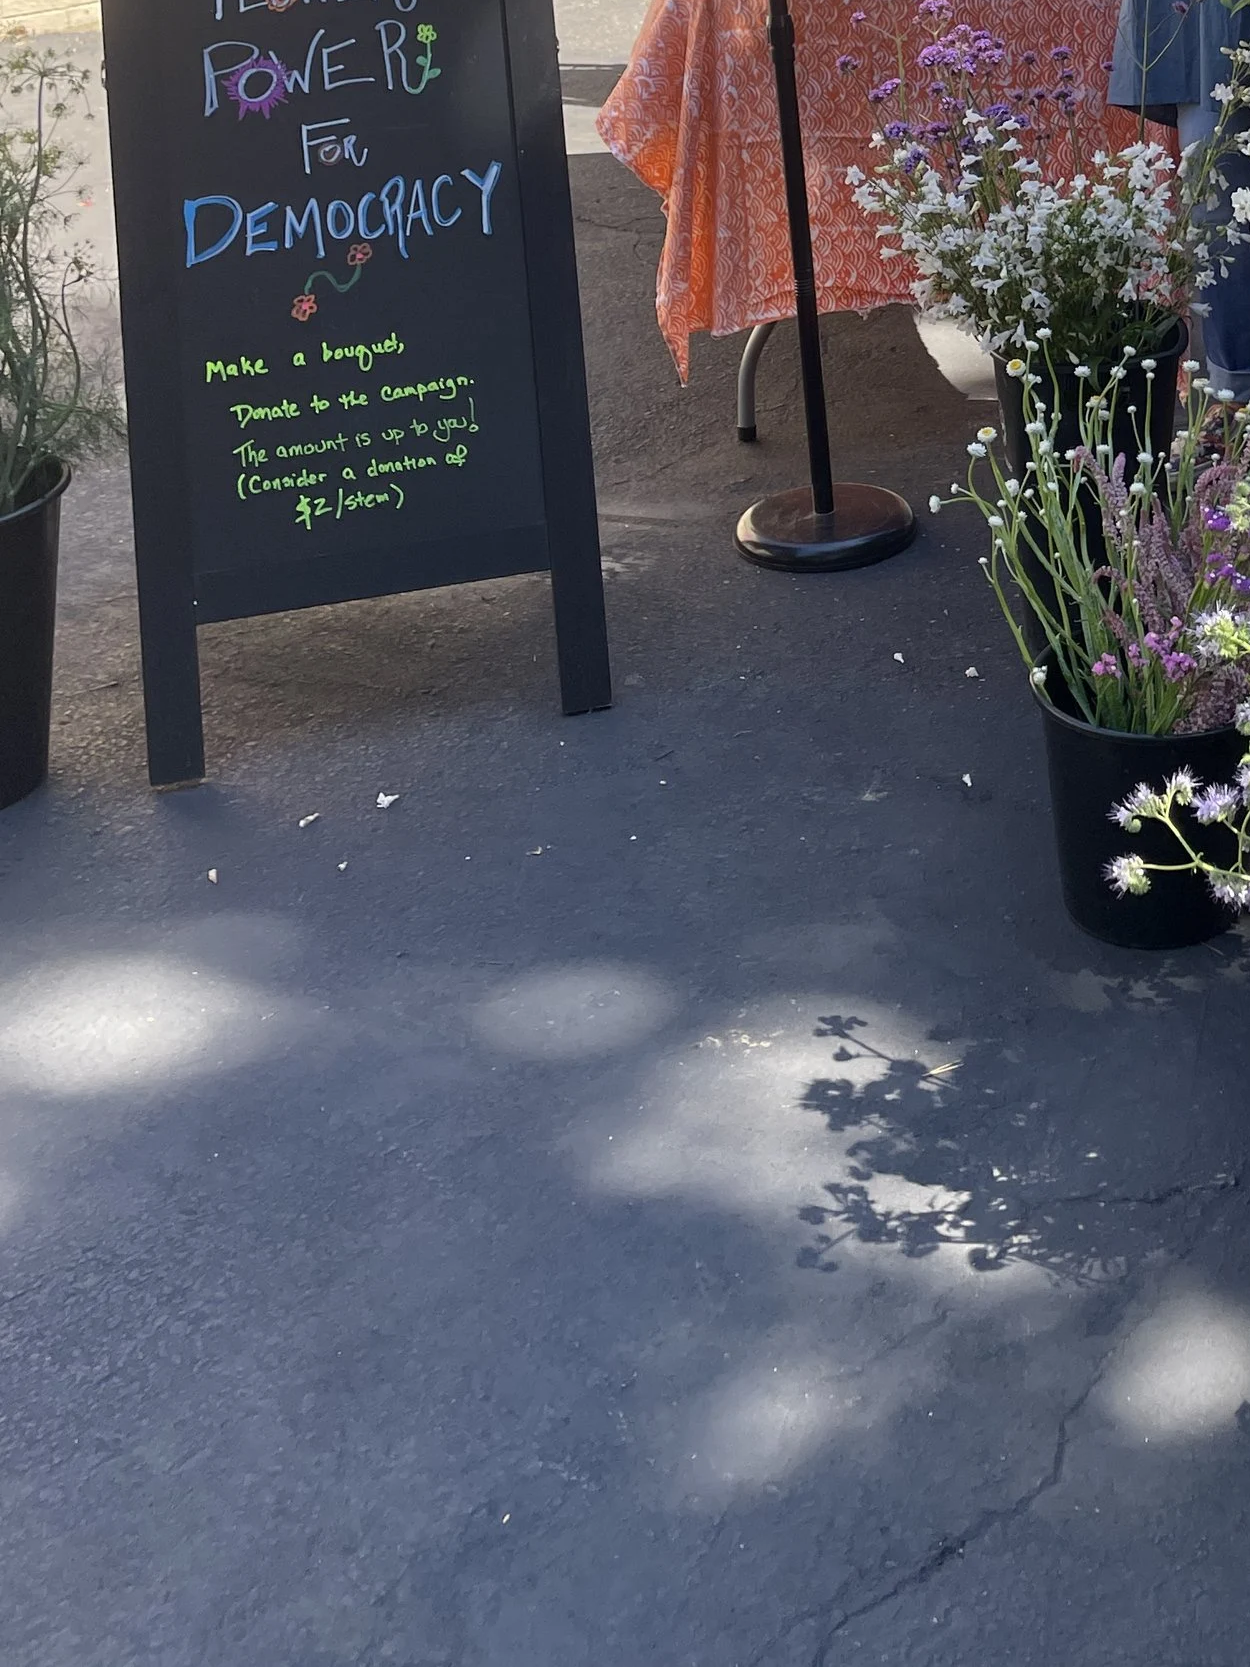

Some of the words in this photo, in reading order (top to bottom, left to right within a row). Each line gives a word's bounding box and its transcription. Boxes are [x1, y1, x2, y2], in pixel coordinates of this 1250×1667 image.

[203, 18, 428, 118] POWER
[300, 117, 369, 175] FOR
[183, 160, 502, 268] DEMOCRACY
[205, 355, 270, 383] Make
[292, 352, 307, 367] a
[229, 398, 302, 429] Donate
[310, 394, 331, 414] to
[338, 390, 369, 410] the
[232, 439, 269, 468] The
[275, 433, 349, 459] amount
[355, 433, 372, 448] is
[381, 428, 405, 445] up
[409, 418, 429, 436] to
[236, 468, 328, 501] (Consider
[341, 467, 357, 481] a
[366, 454, 437, 478] donation
[445, 444, 468, 467] of
